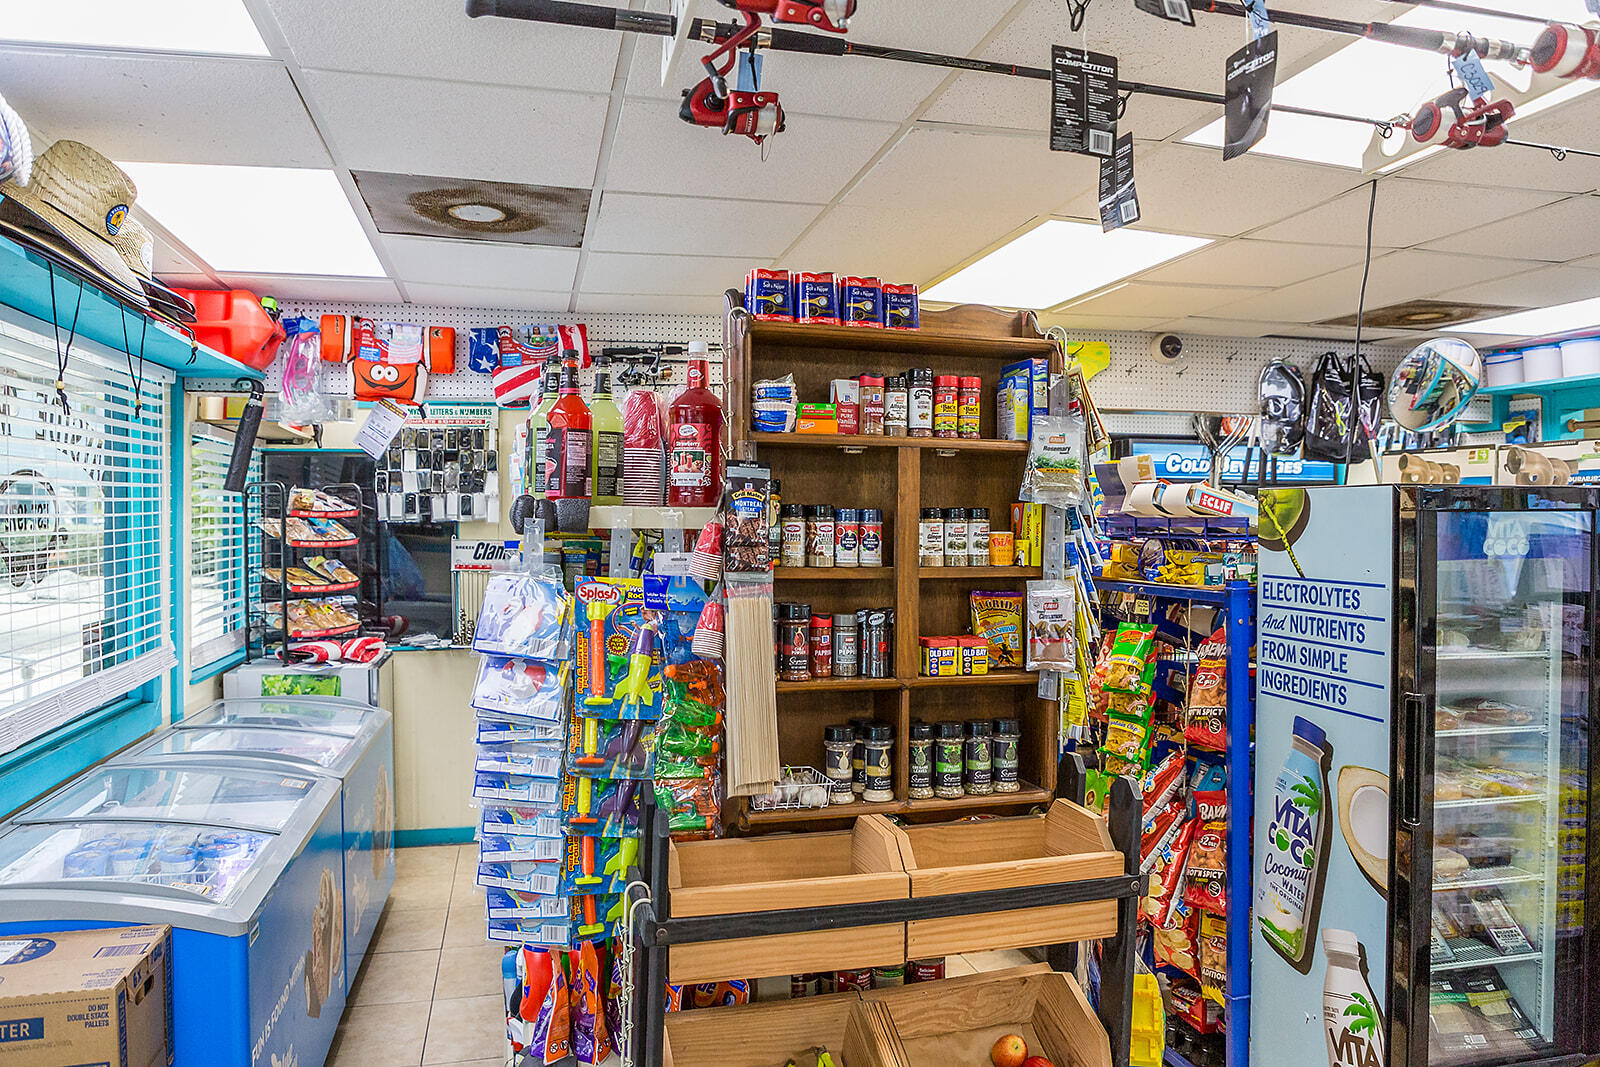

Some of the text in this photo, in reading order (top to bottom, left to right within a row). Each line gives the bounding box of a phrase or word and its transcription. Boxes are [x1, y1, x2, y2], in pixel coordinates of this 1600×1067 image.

[1055, 57, 1114, 74] COMPETITOR
[1227, 50, 1275, 81] COMPETITOR
[460, 408, 492, 416] NUMBERS
[1166, 453, 1211, 474] COLD
[734, 500, 763, 508] MONTREAL
[1206, 495, 1232, 514] CLIF
[579, 586, 618, 600] Splash
[1262, 581, 1361, 610] ELECTROLYTES
[1262, 613, 1366, 644] And NUTRIENTS
[942, 649, 954, 657] BAY
[1262, 640, 1348, 674] FROM SIMPLE
[1261, 669, 1347, 706] INGREDIENTS
[1202, 708, 1223, 716] SPICY
[1275, 794, 1314, 845] VITA
[1268, 821, 1316, 868] COCO
[1202, 869, 1223, 879] SPICY
[1264, 852, 1311, 886] Coconut
[1270, 882, 1304, 913] THE ORIGINAL
[1282, 877, 1305, 903] WATER
[1202, 967, 1227, 981] ADITION
[67, 1014, 89, 1022] DOUBLE
[85, 1019, 109, 1028] PALLETS
[252, 1030, 265, 1067] FUN
[271, 983, 290, 1031] FOUND
[0, 1022, 30, 1038] TER
[1328, 1026, 1381, 1067] VITA
